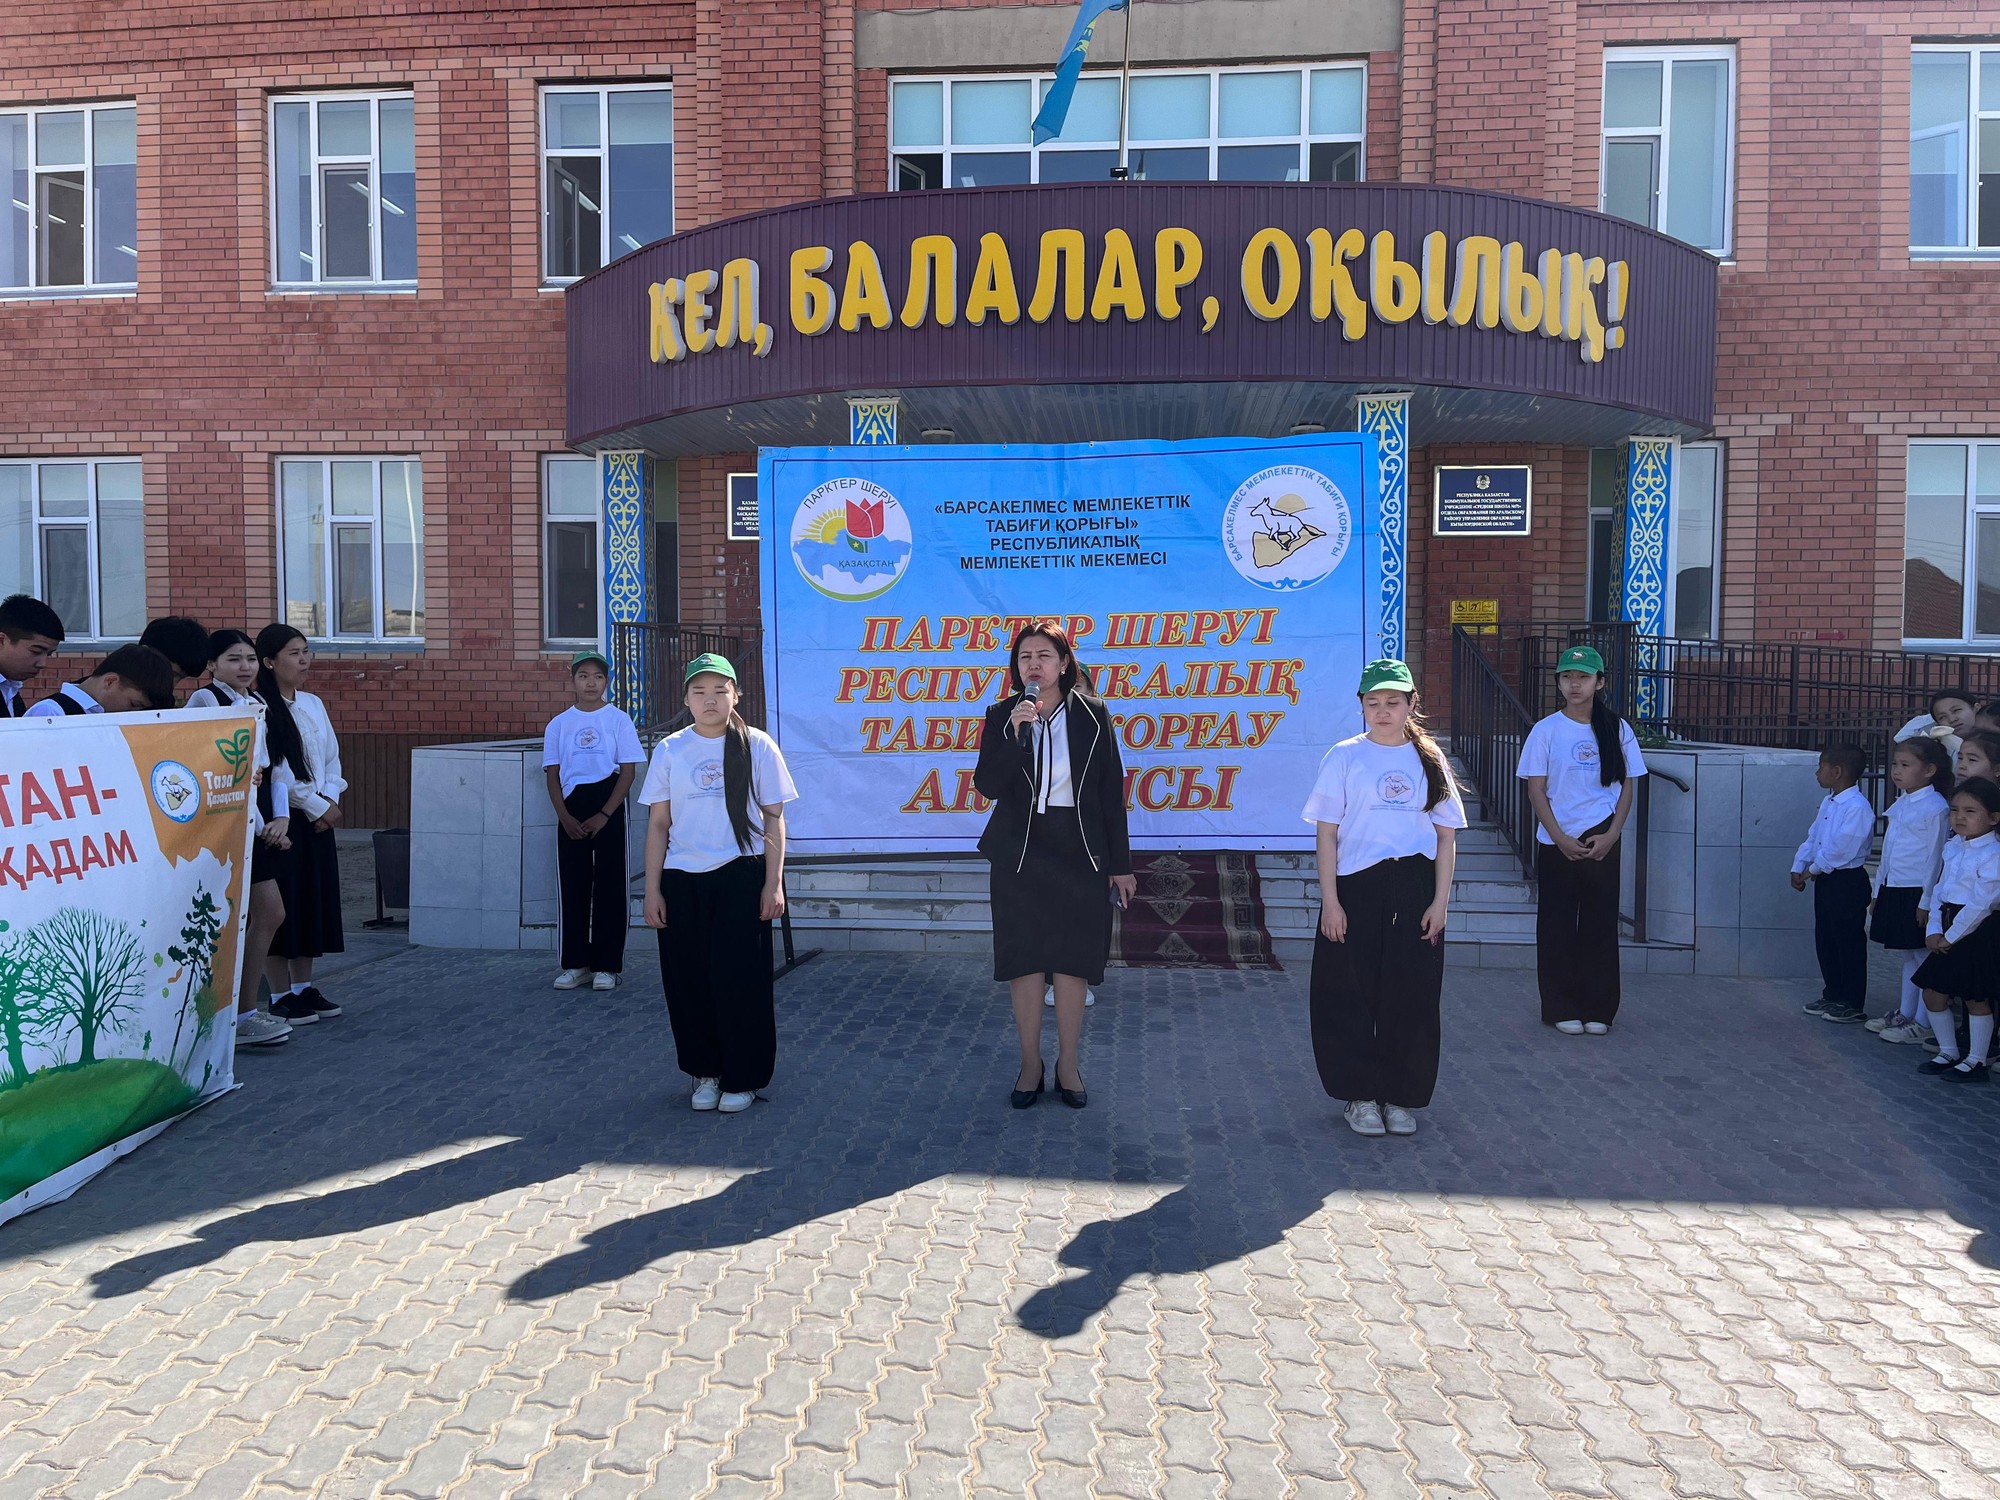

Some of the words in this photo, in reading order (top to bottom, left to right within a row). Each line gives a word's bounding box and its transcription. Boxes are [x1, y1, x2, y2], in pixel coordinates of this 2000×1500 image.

[648, 258, 773, 363] КЕЛ,
[790, 227, 1219, 336] БАЛАЛАР,
[1241, 227, 1630, 363] ОҚЫЛЫҚ!
[803, 478, 857, 510] ПАРКТЕР
[860, 480, 898, 510] ШЕРУІ
[935, 500, 1068, 514] «БАРСАКЕЛМЕС
[1073, 494, 1191, 512] МЕМЛЕКЕТТІК
[986, 518, 1050, 533] ТАБИҒИ
[1055, 516, 1139, 533] ҚОРЫҒЫ»
[1226, 488, 1247, 562] БАРСАКЕЛМЕС
[1245, 466, 1315, 490] МЕМЛЕКЕТТІК
[960, 555, 1076, 570] МЕМЛЕКЕТТІК
[1080, 551, 1167, 567] МЕКЕМЕСІ
[990, 534, 1140, 551] РЕСПУБЛИКАЛЫҚ
[838, 560, 895, 569] ҚАЗАҚСТАН
[859, 613, 1095, 652] ПАРКТР
[1102, 608, 1279, 651] ШЕРУІ
[834, 658, 1305, 706] РЕСПУКАЛЫҚ
[1112, 710, 1286, 751] ОРҒАУ
[0, 765, 118, 828] ТАН-
[203, 770, 234, 790] Таза
[899, 765, 1242, 814] АКСЫ
